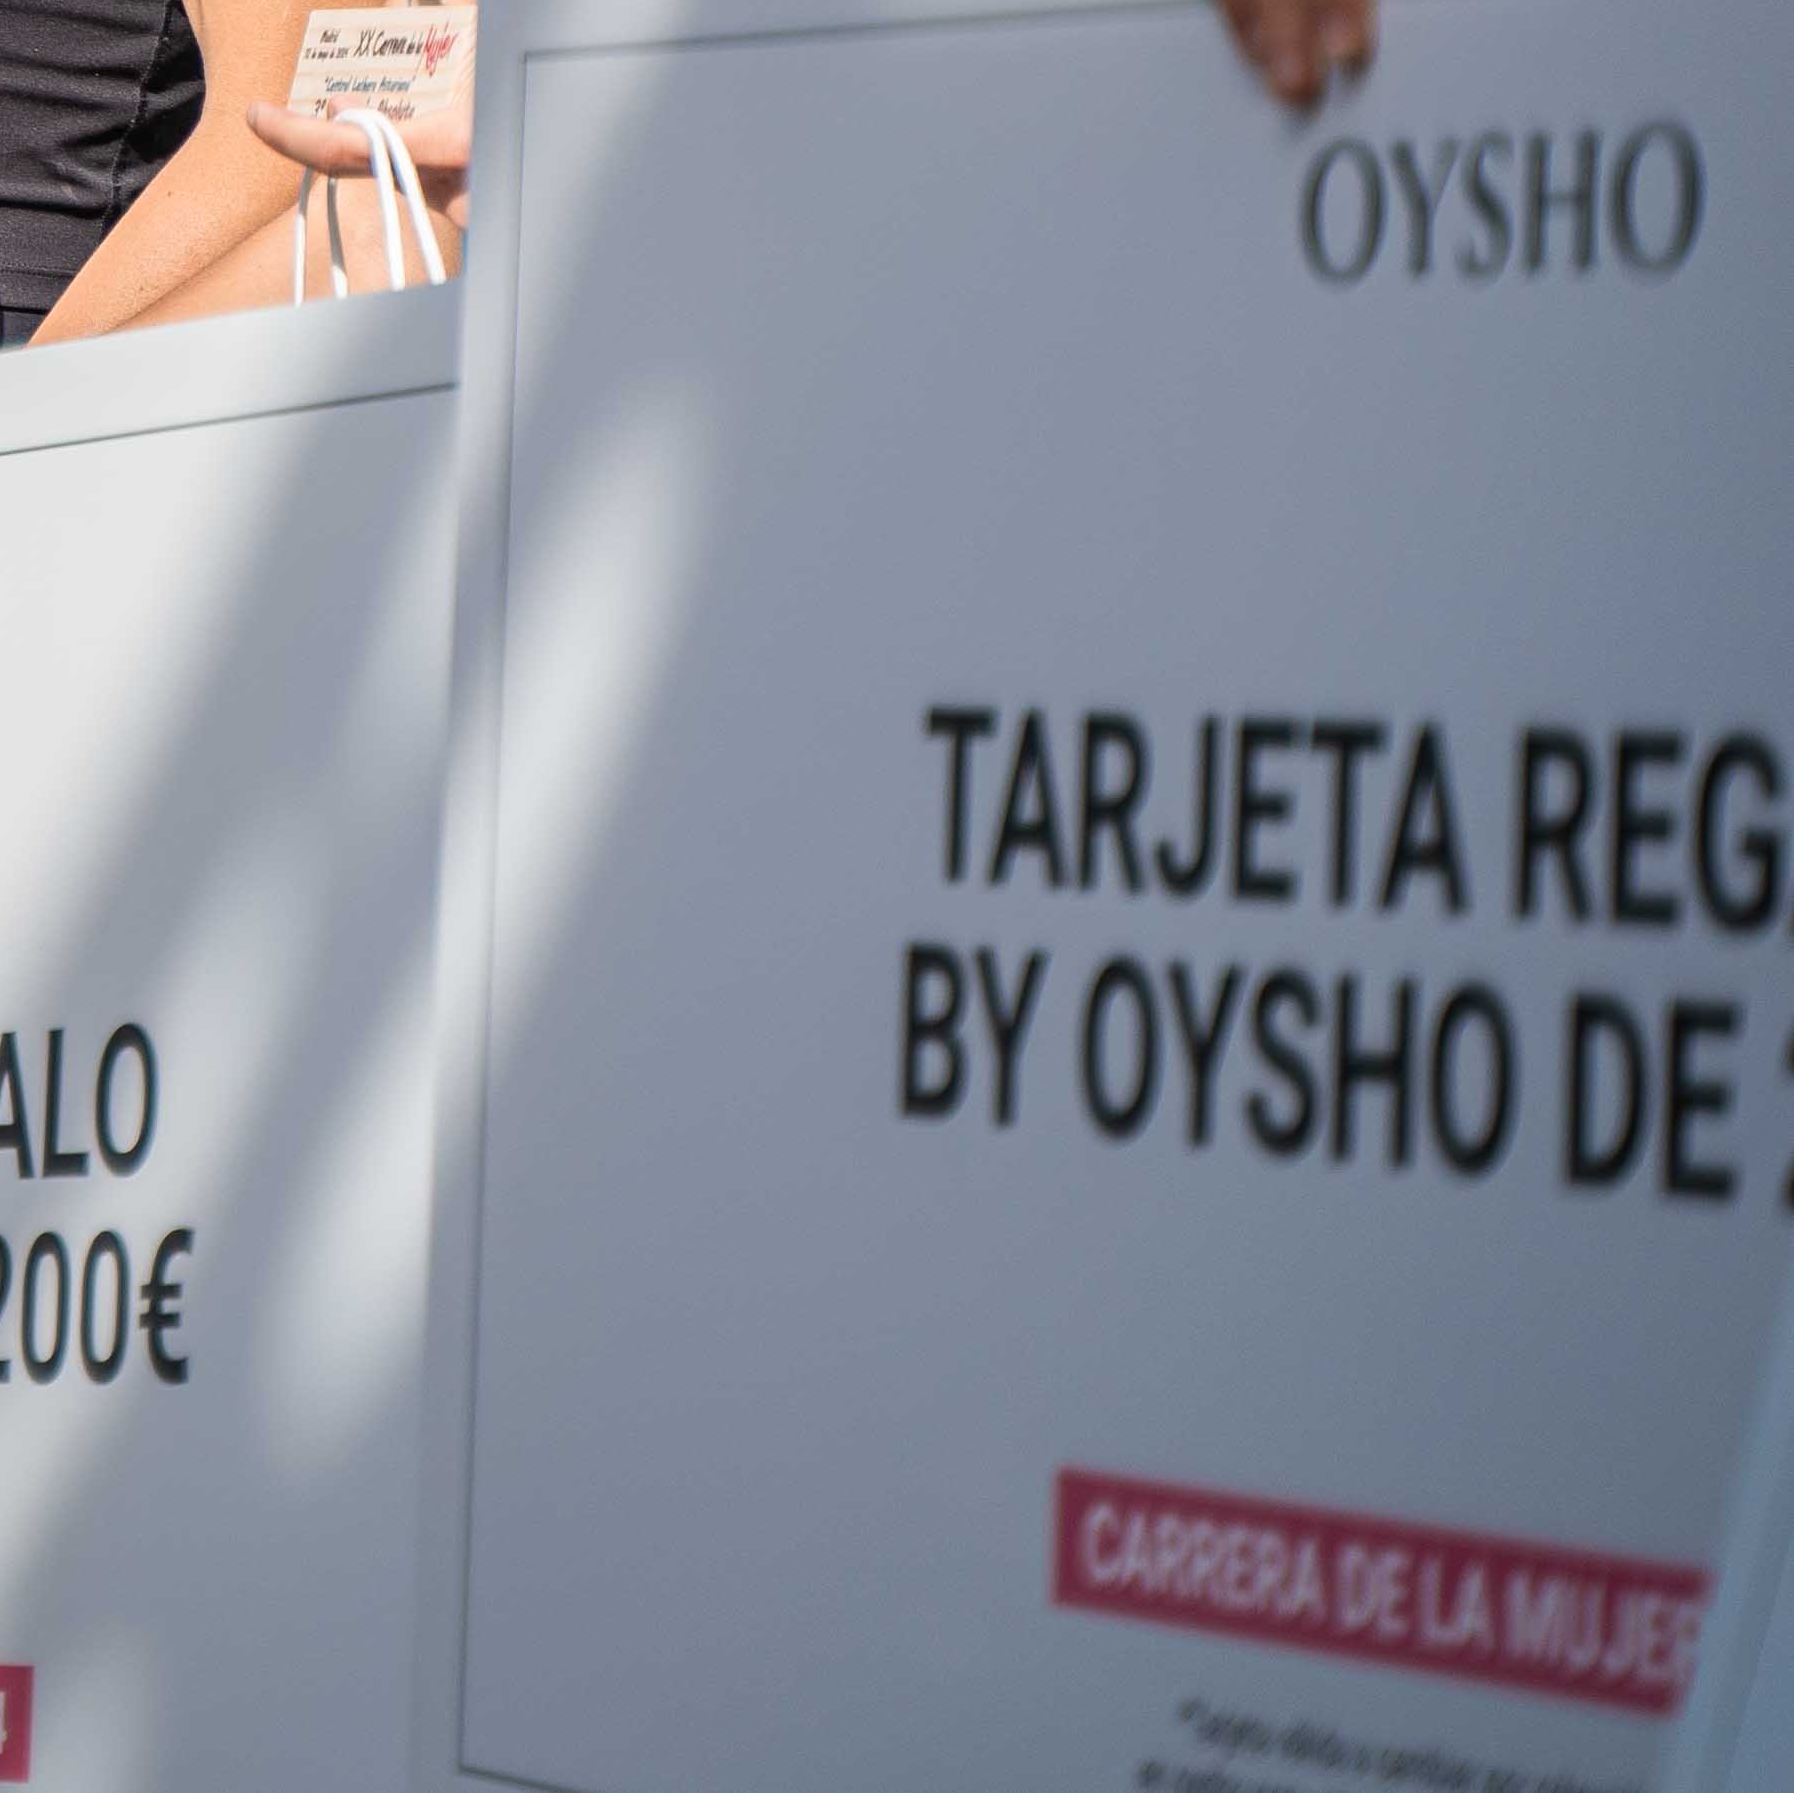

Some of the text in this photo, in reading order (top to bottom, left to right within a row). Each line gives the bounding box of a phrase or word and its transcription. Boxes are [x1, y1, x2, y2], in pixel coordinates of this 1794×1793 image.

[1299, 117, 1708, 289] OYSHO
[924, 704, 1794, 936] TARJETA REG
[897, 940, 1049, 1130] BY
[1080, 954, 1518, 1178] OYSHO
[1560, 986, 1744, 1201] DE
[1081, 1501, 1324, 1618] CARRERA
[1335, 1542, 1410, 1639] DE
[1420, 1556, 1490, 1653] LA
